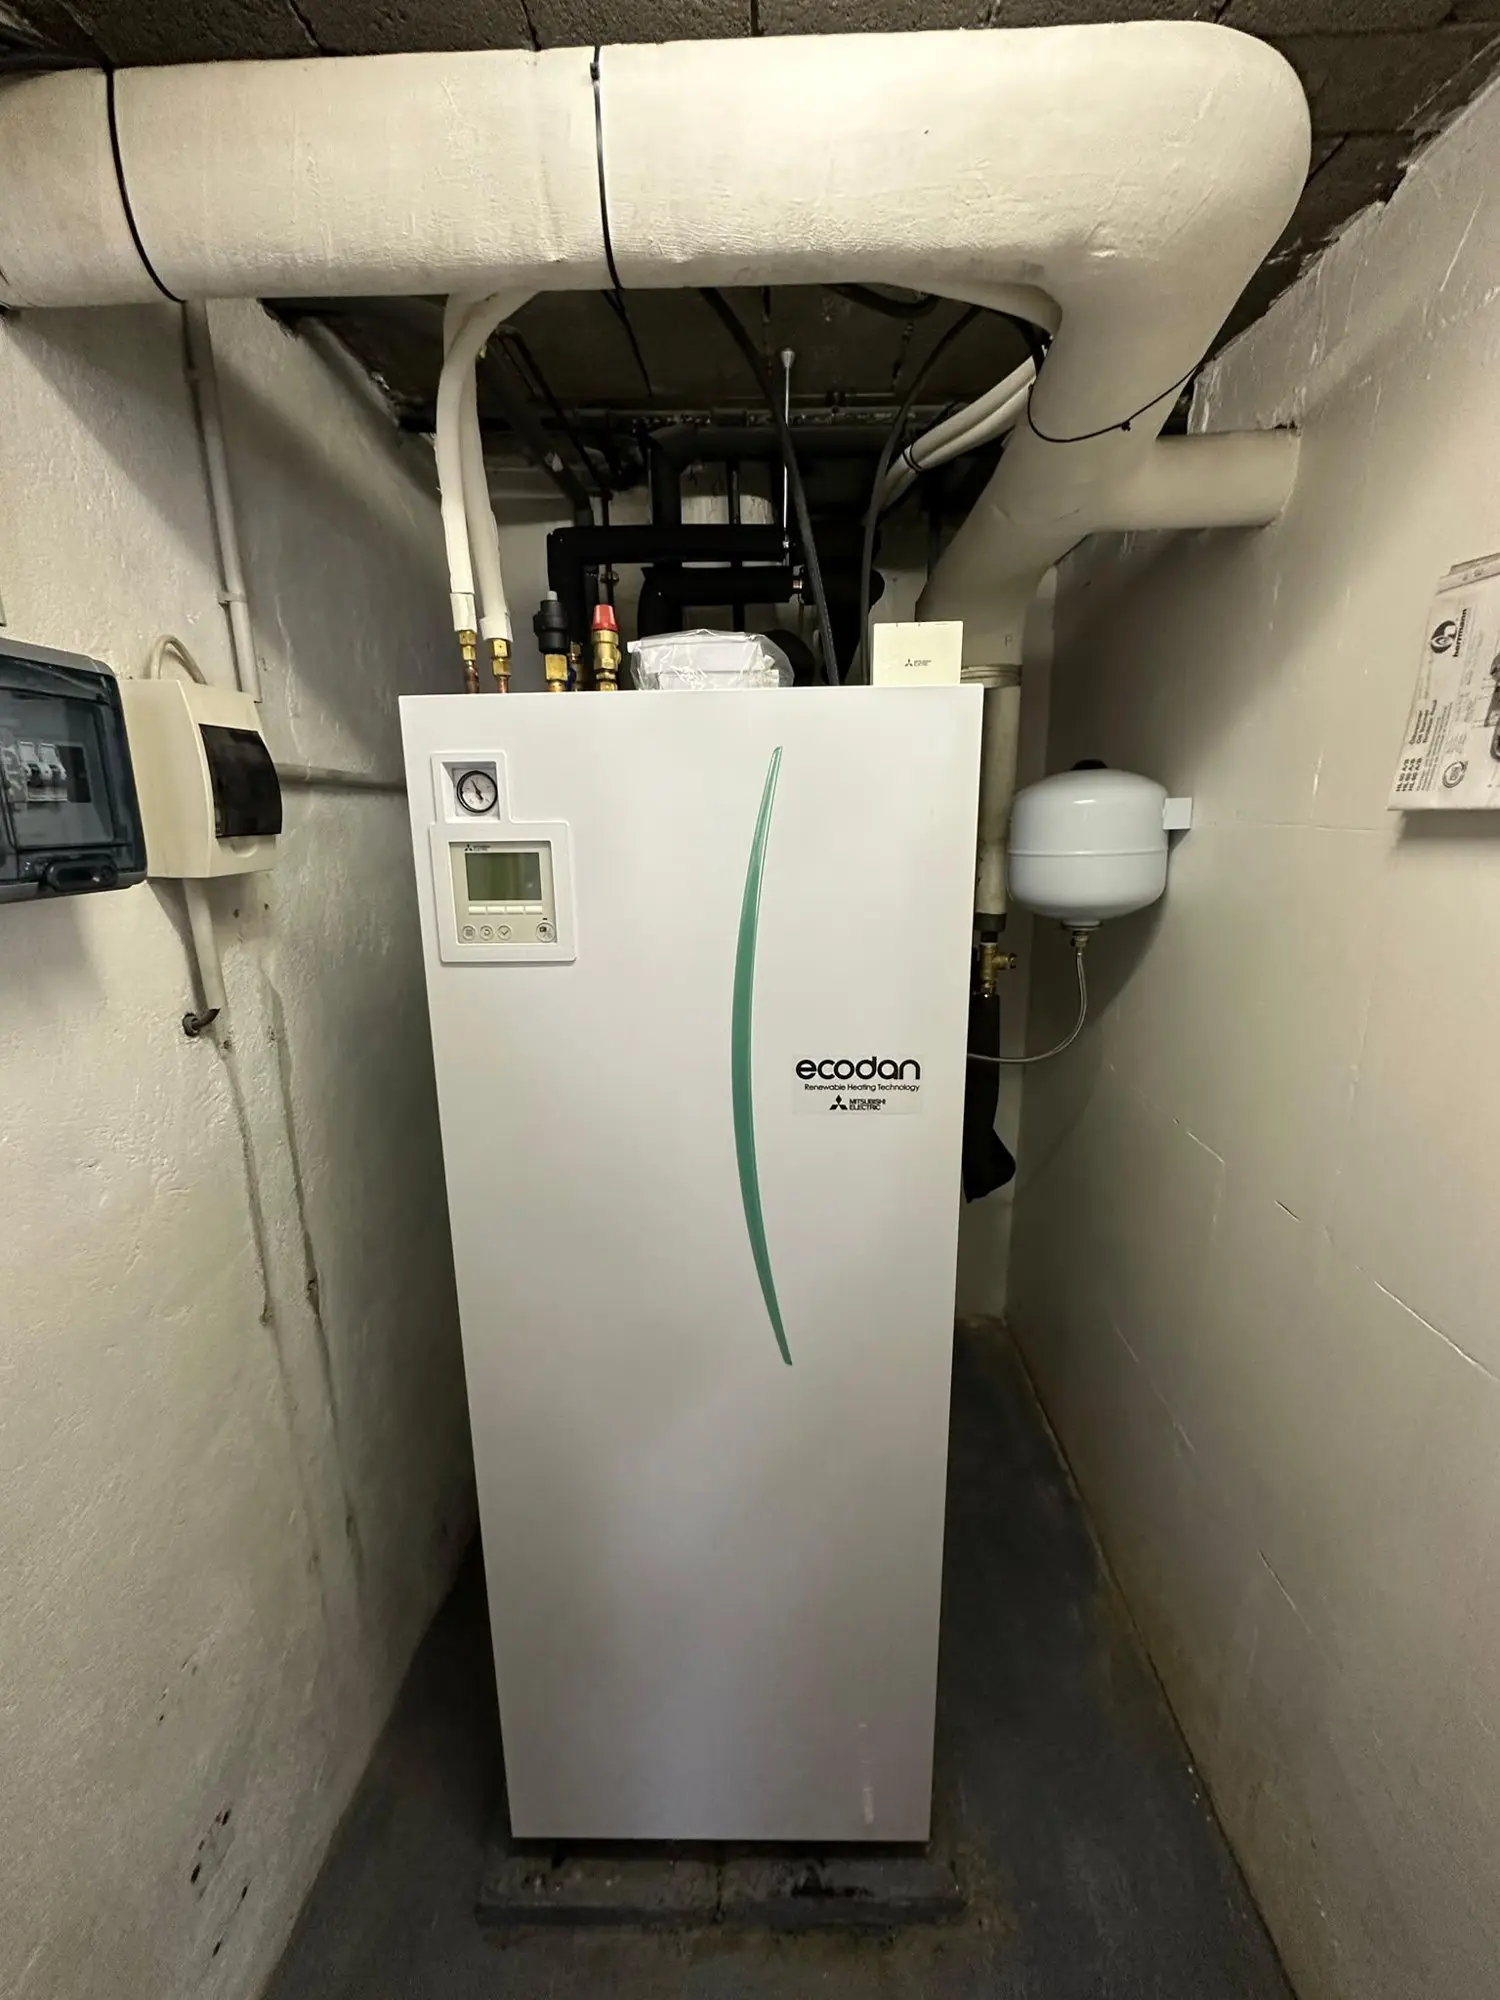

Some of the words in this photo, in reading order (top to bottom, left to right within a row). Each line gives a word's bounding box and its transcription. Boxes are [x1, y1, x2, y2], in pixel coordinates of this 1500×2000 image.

[1452, 608, 1467, 657] herrmann
[795, 1056, 921, 1080] ecodan
[804, 1083, 846, 1091] Renewable
[847, 1083, 876, 1092] Heating
[877, 1083, 920, 1092] Technology
